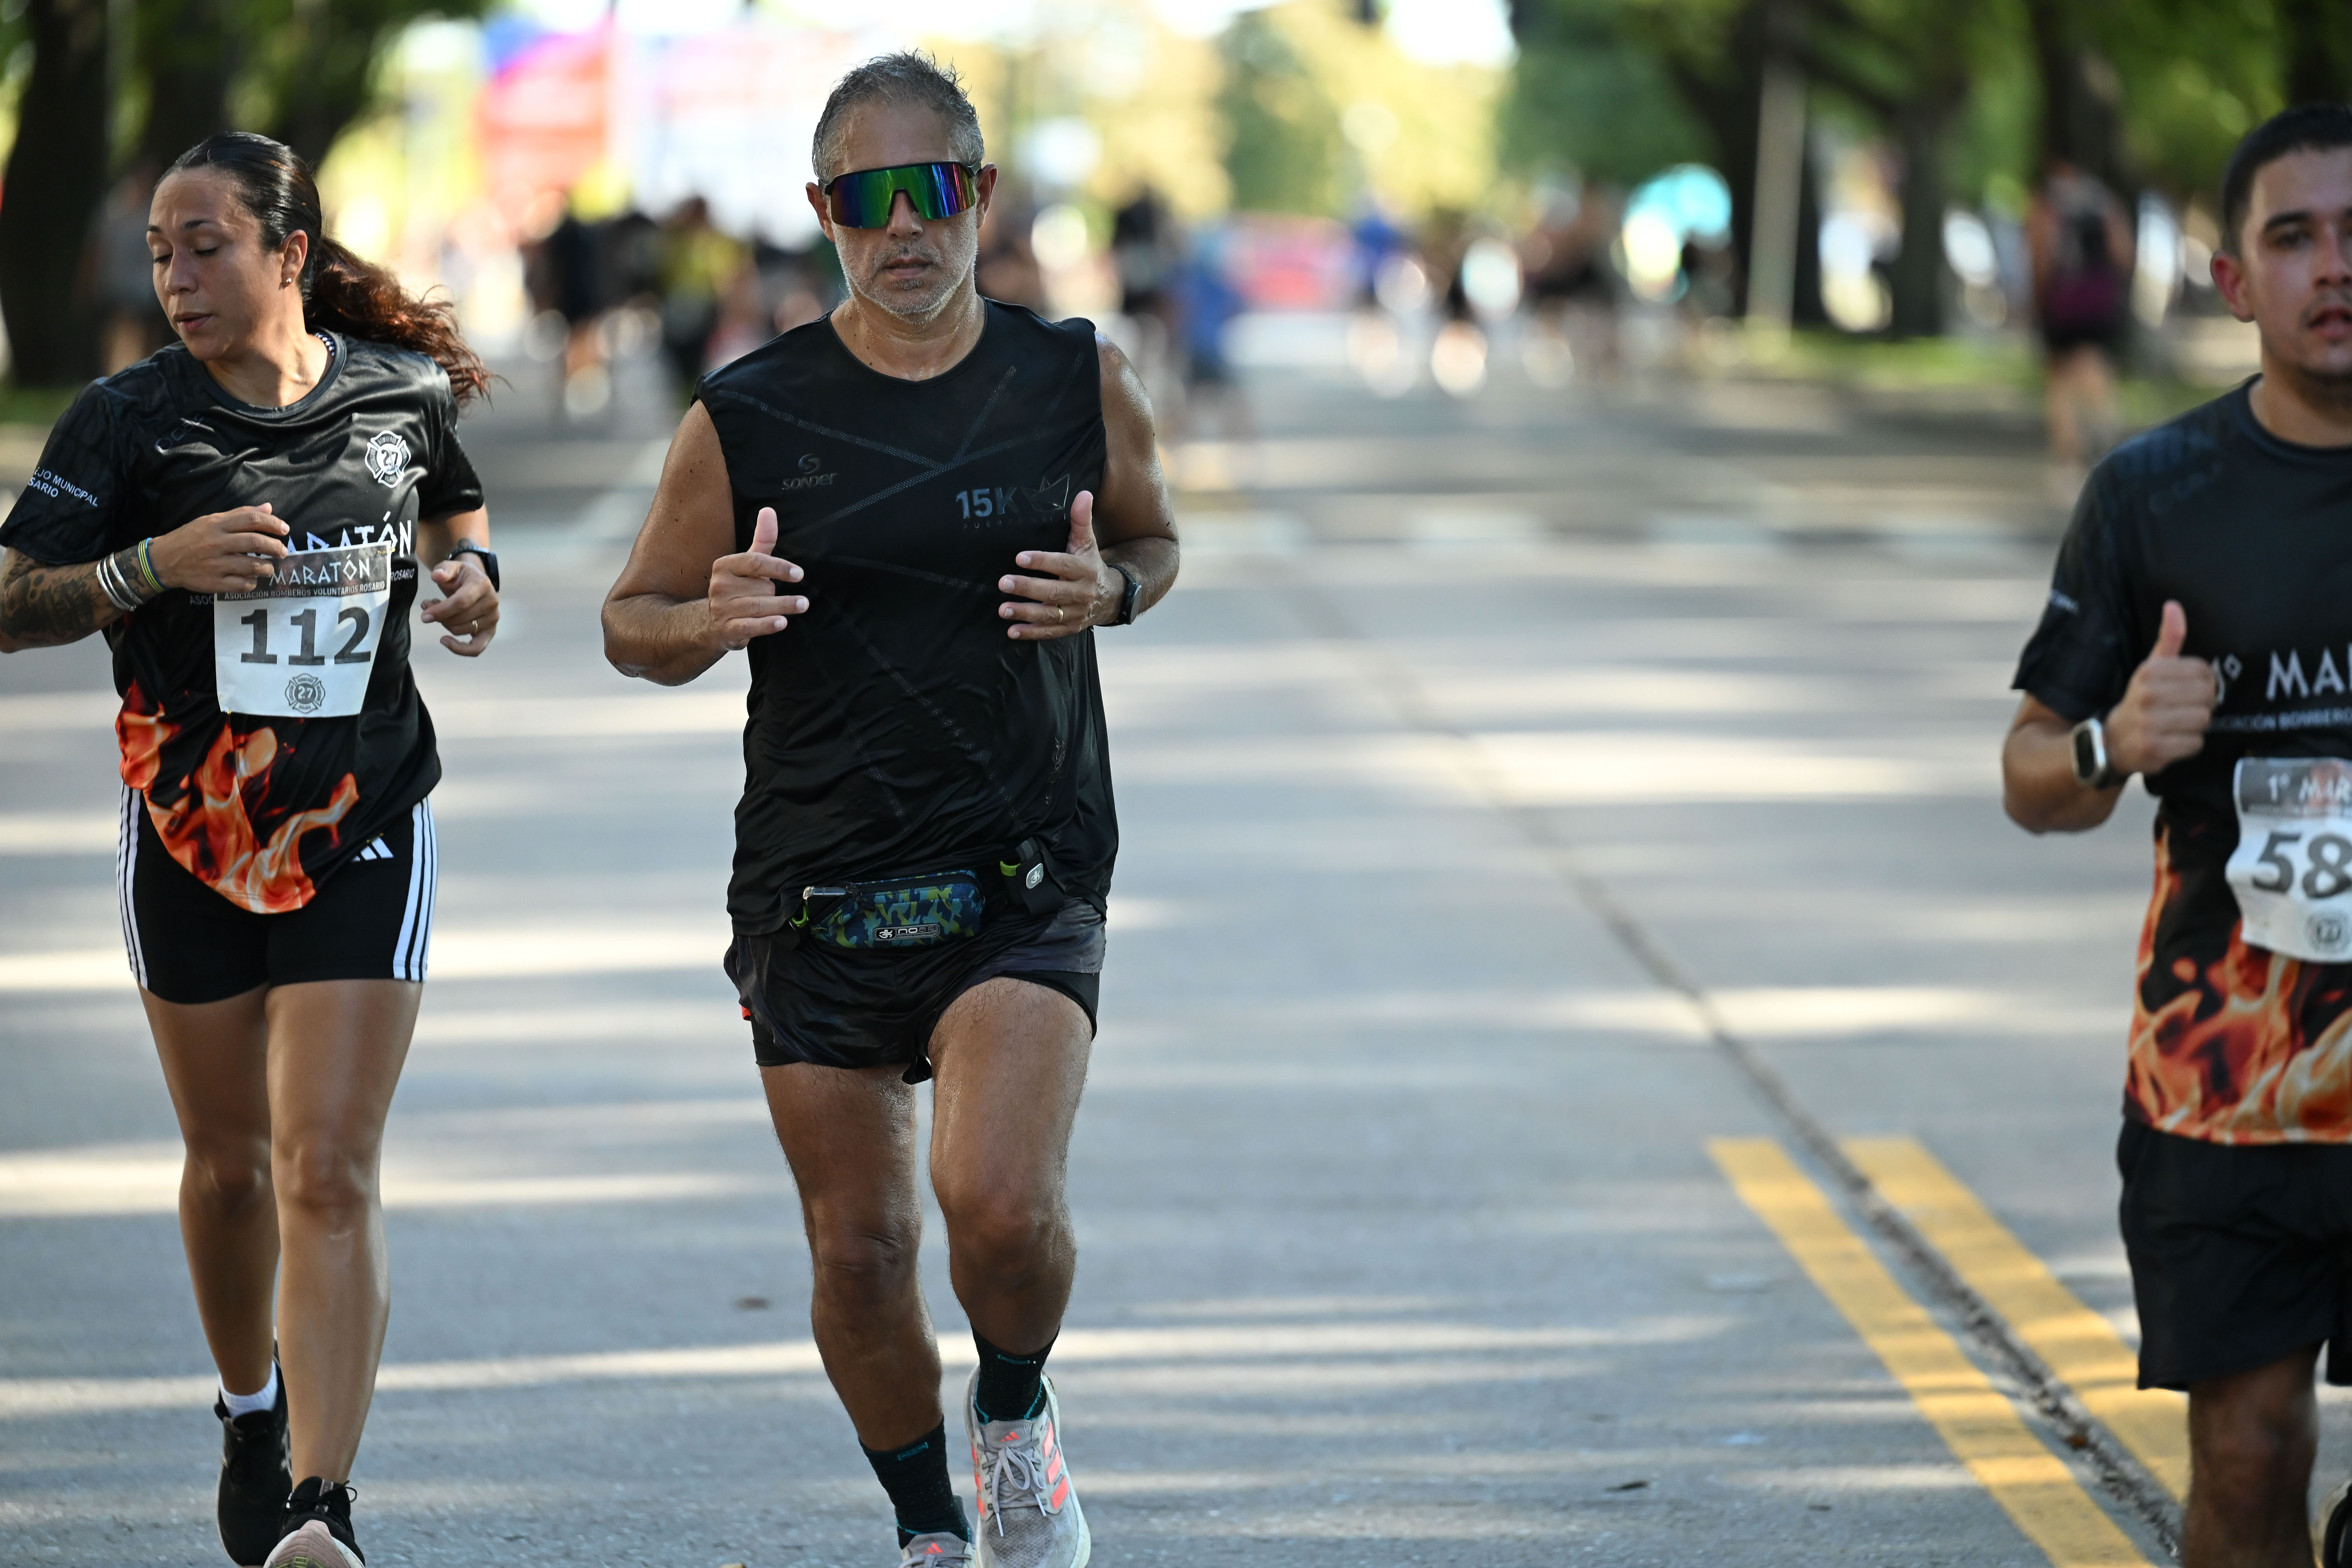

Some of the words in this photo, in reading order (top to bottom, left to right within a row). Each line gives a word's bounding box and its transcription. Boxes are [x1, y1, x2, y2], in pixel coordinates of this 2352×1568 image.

[381, 449, 398, 467] 27
[52, 475, 98, 507] MUNICIPAL
[956, 487, 1020, 519] 15K
[269, 554, 370, 586] MARATÓN
[271, 588, 311, 597] BOMBEROS
[313, 584, 359, 596] VOLUNTARIOS
[360, 580, 385, 593] ROSARIO
[241, 607, 371, 665] 112
[2266, 642, 2352, 701] MA
[298, 686, 313, 700] 27
[2252, 831, 2352, 900] 58
